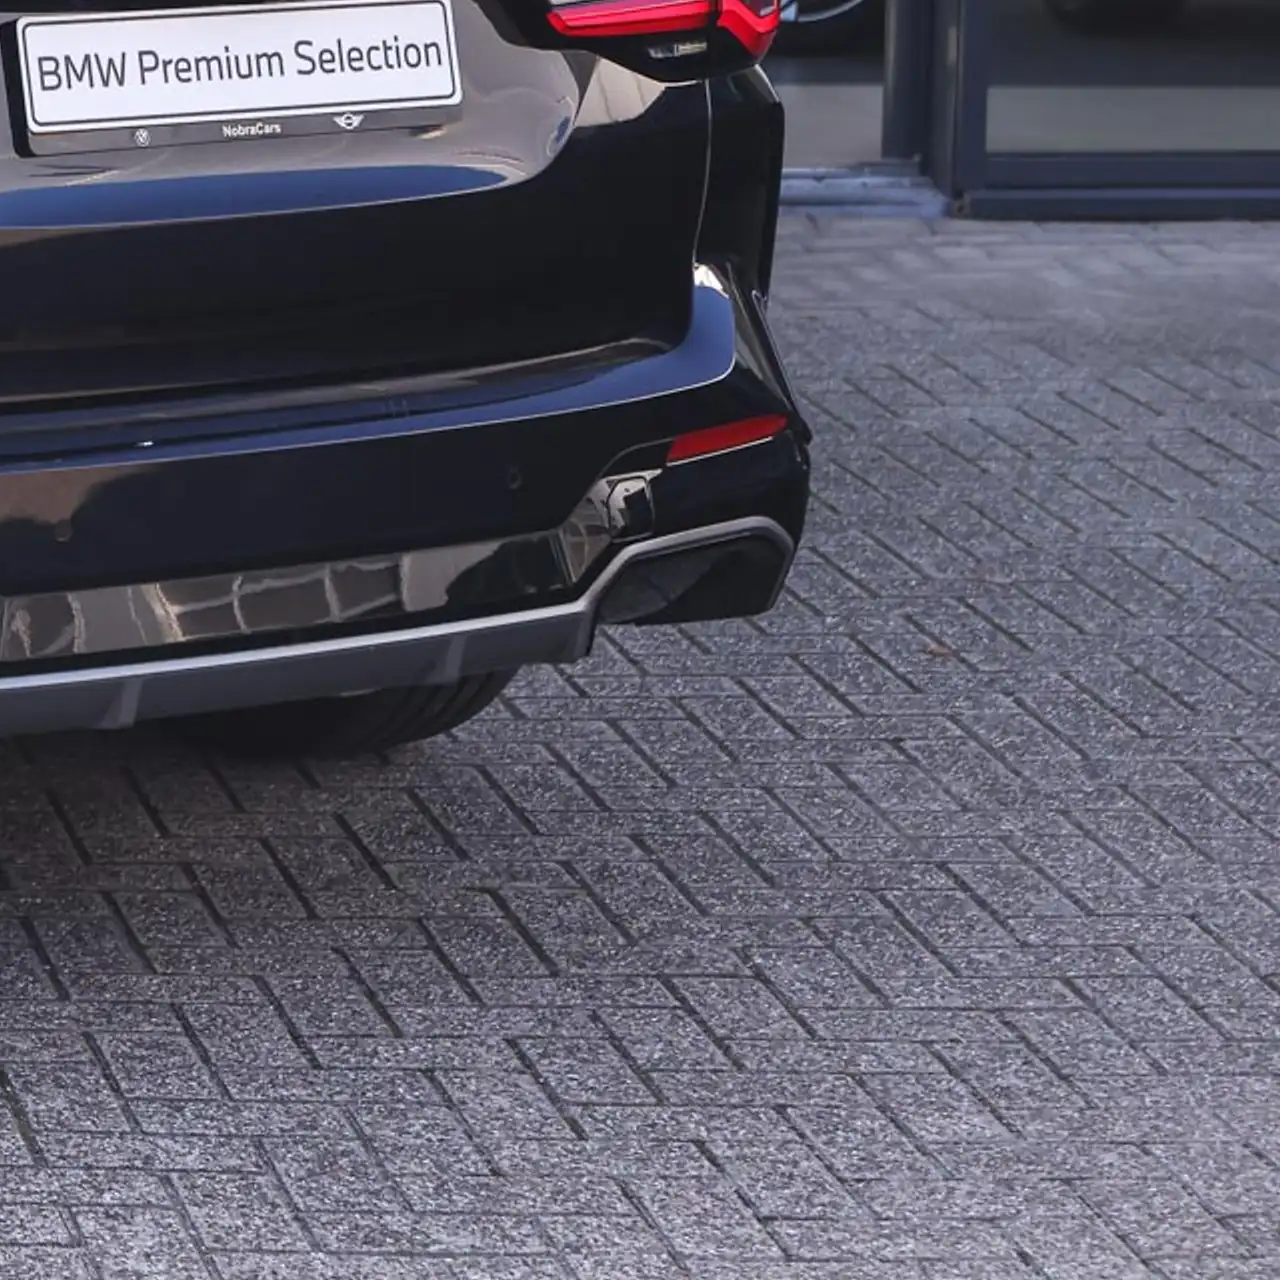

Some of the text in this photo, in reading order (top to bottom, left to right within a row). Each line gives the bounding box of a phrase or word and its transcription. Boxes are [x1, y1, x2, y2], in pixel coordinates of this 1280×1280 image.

[38, 35, 441, 91] BMW Premium Selection
[222, 122, 282, 138] NobraCars
